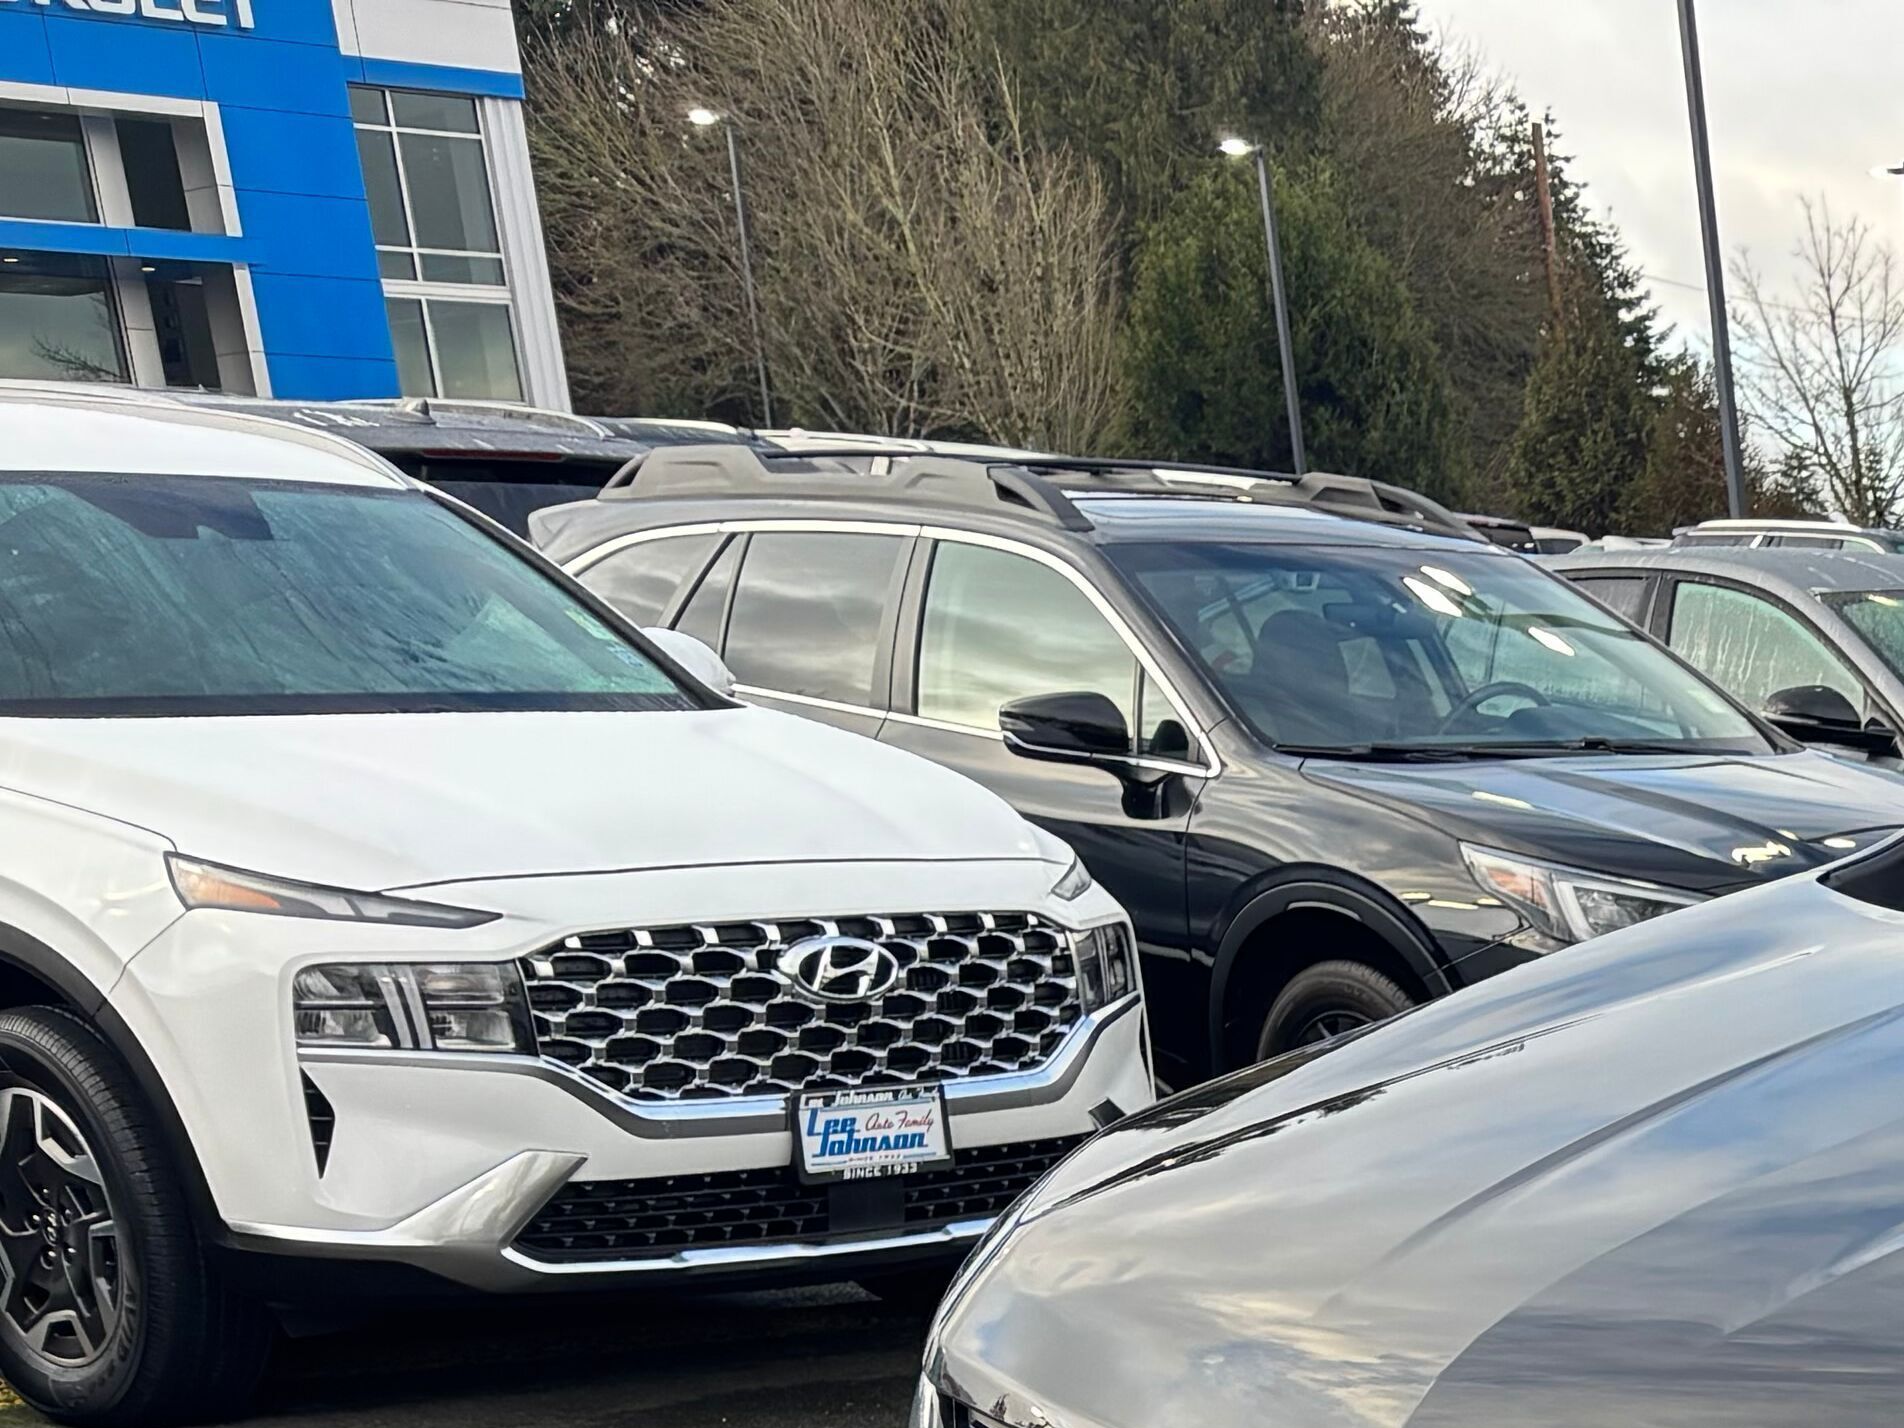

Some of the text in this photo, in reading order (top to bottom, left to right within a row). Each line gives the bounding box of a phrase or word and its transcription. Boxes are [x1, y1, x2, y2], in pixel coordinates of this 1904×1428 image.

[807, 1108, 861, 1136] Lee
[865, 1108, 934, 1133] Auto Family
[811, 1129, 929, 1158] Johnson
[843, 1162, 918, 1180] SINCE 1933
